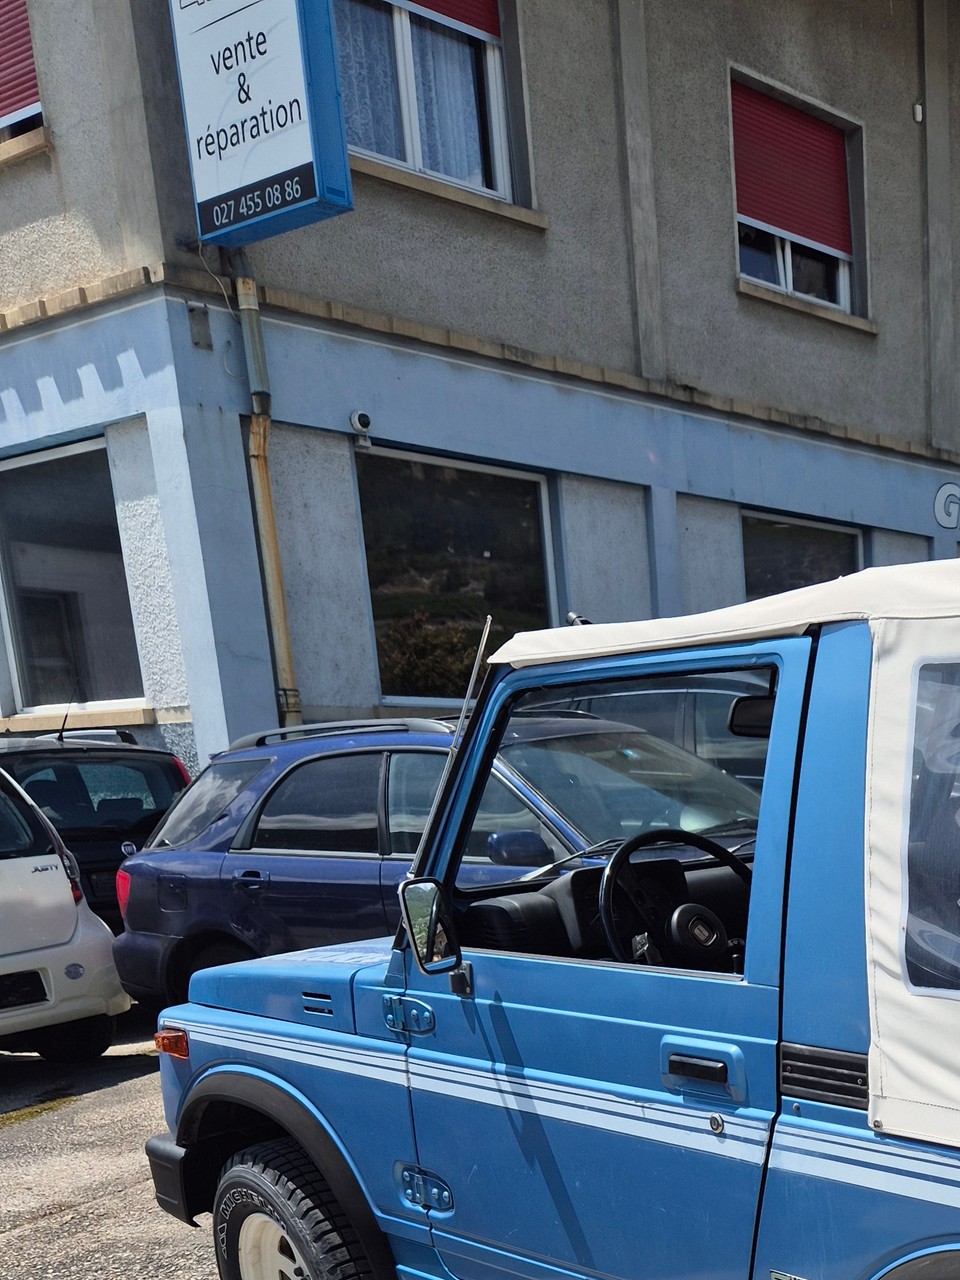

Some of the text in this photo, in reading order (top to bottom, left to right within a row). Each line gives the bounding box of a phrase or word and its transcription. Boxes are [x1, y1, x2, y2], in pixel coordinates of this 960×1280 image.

[210, 31, 268, 75] vente
[237, 72, 252, 104] &
[196, 98, 302, 161] réparation
[213, 176, 301, 226] 027 455 08 86
